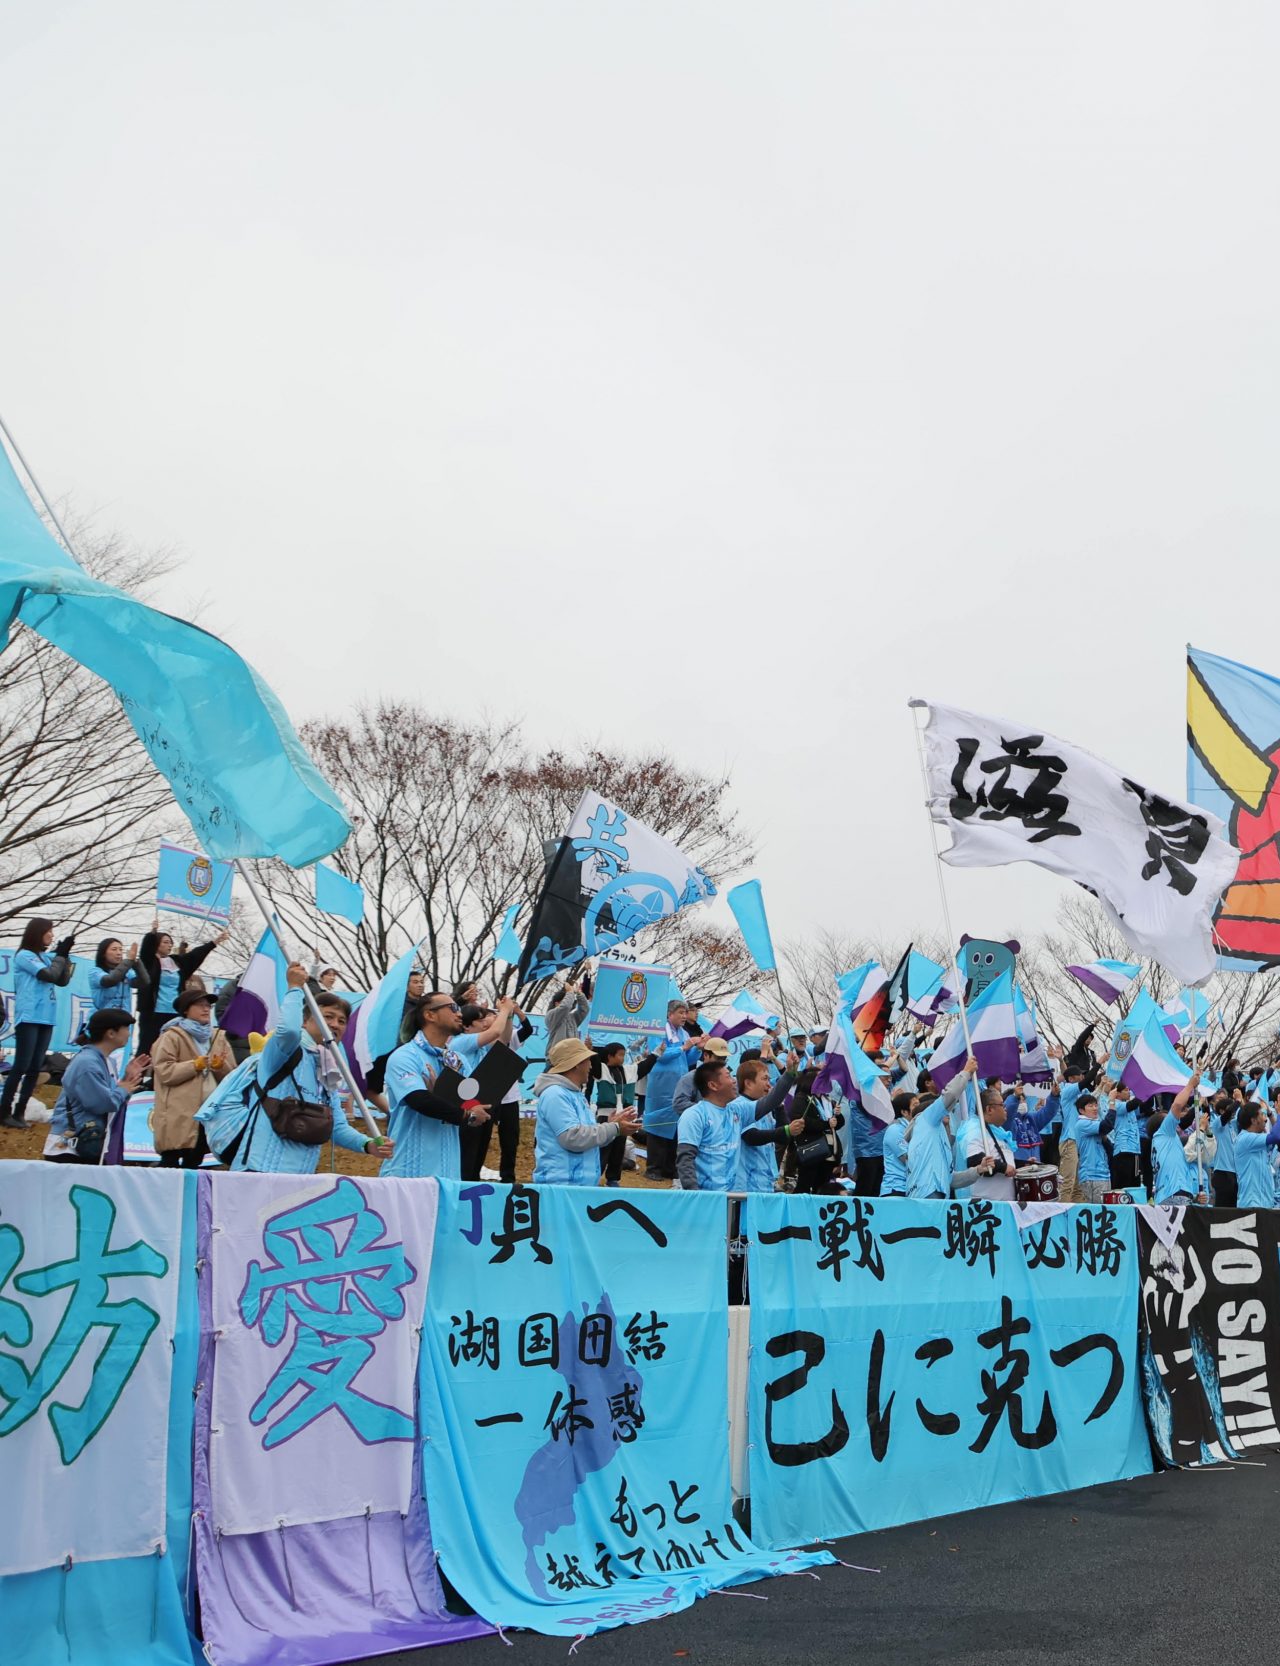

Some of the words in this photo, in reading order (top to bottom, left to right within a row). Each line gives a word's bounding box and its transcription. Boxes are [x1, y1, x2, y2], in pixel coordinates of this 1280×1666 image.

[596, 1013, 624, 1025] Reilac
[626, 1016, 650, 1029] Shiga
[651, 1019, 662, 1028] FC
[1209, 1213, 1264, 1286] YO
[239, 1177, 417, 1450] 愛
[448, 1310, 668, 1368] 湖国団結
[764, 1296, 1124, 1467] 己に克つ
[475, 1383, 646, 1444] 一体感
[609, 1476, 700, 1538] もっと
